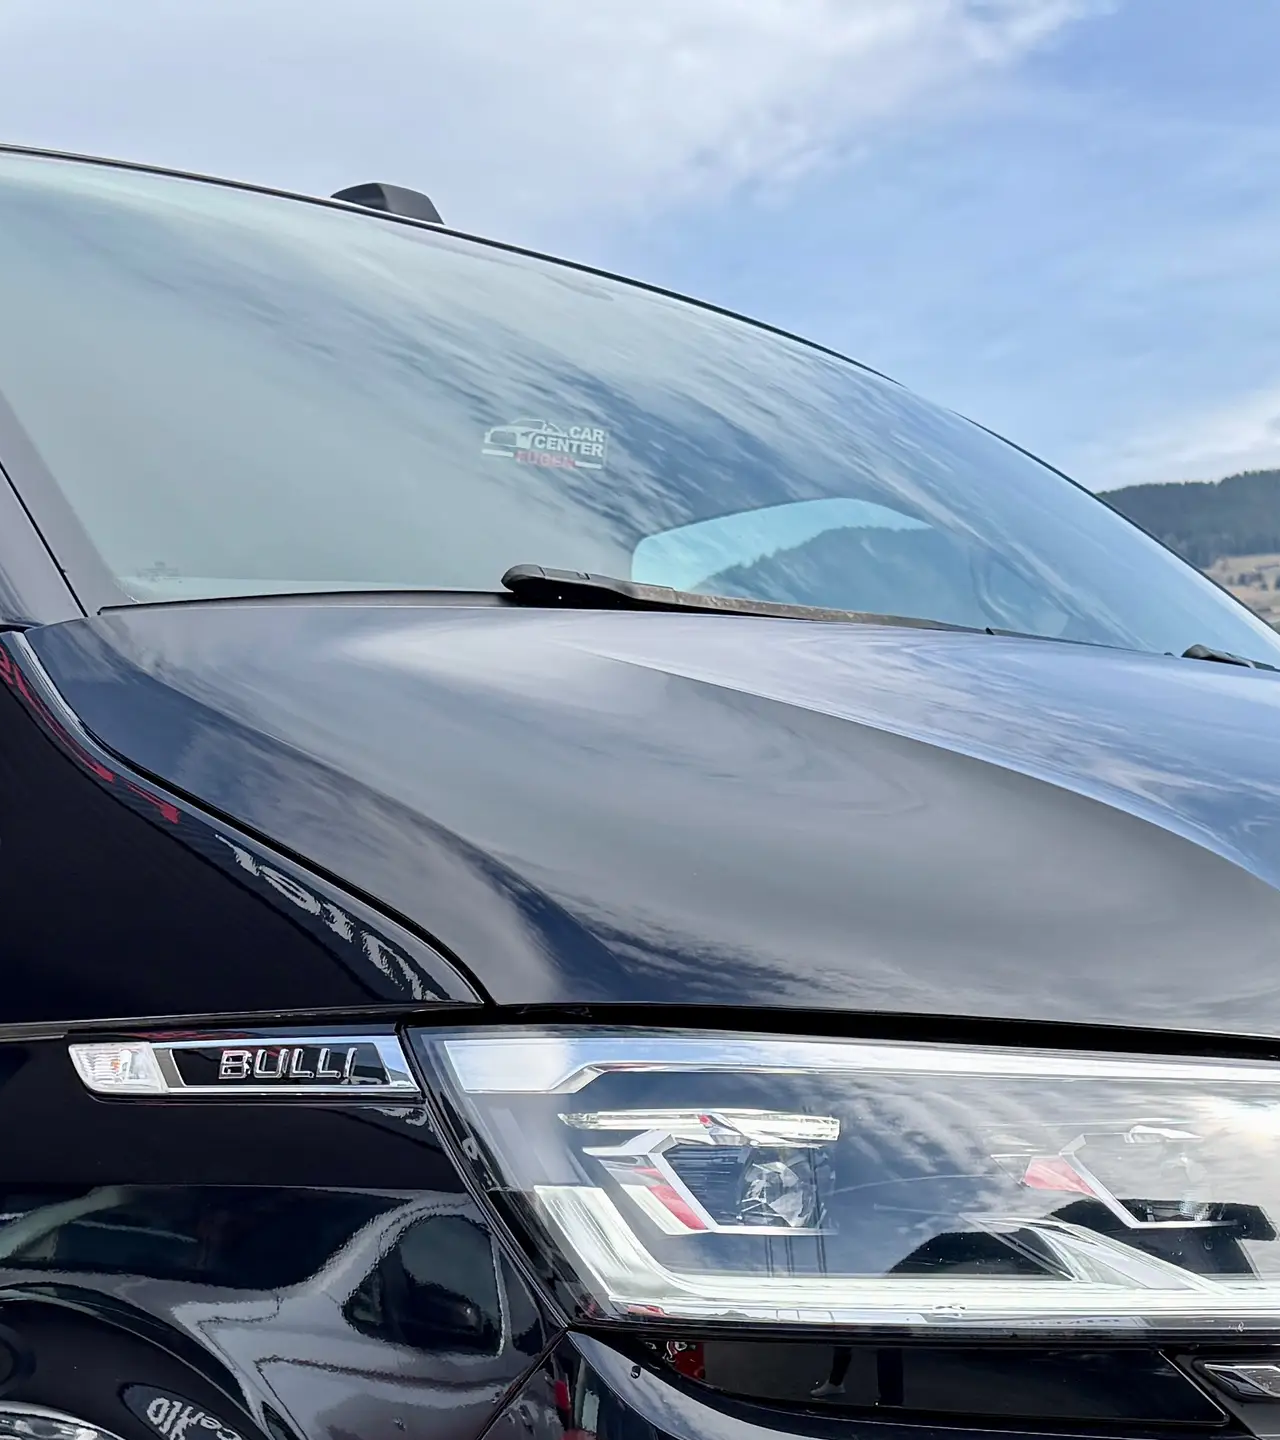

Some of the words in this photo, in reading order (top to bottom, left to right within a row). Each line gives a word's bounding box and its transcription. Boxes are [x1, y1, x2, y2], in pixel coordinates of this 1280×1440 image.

[534, 434, 603, 457] CENTER
[569, 426, 604, 442] CAR
[218, 1047, 358, 1079] BULLI
